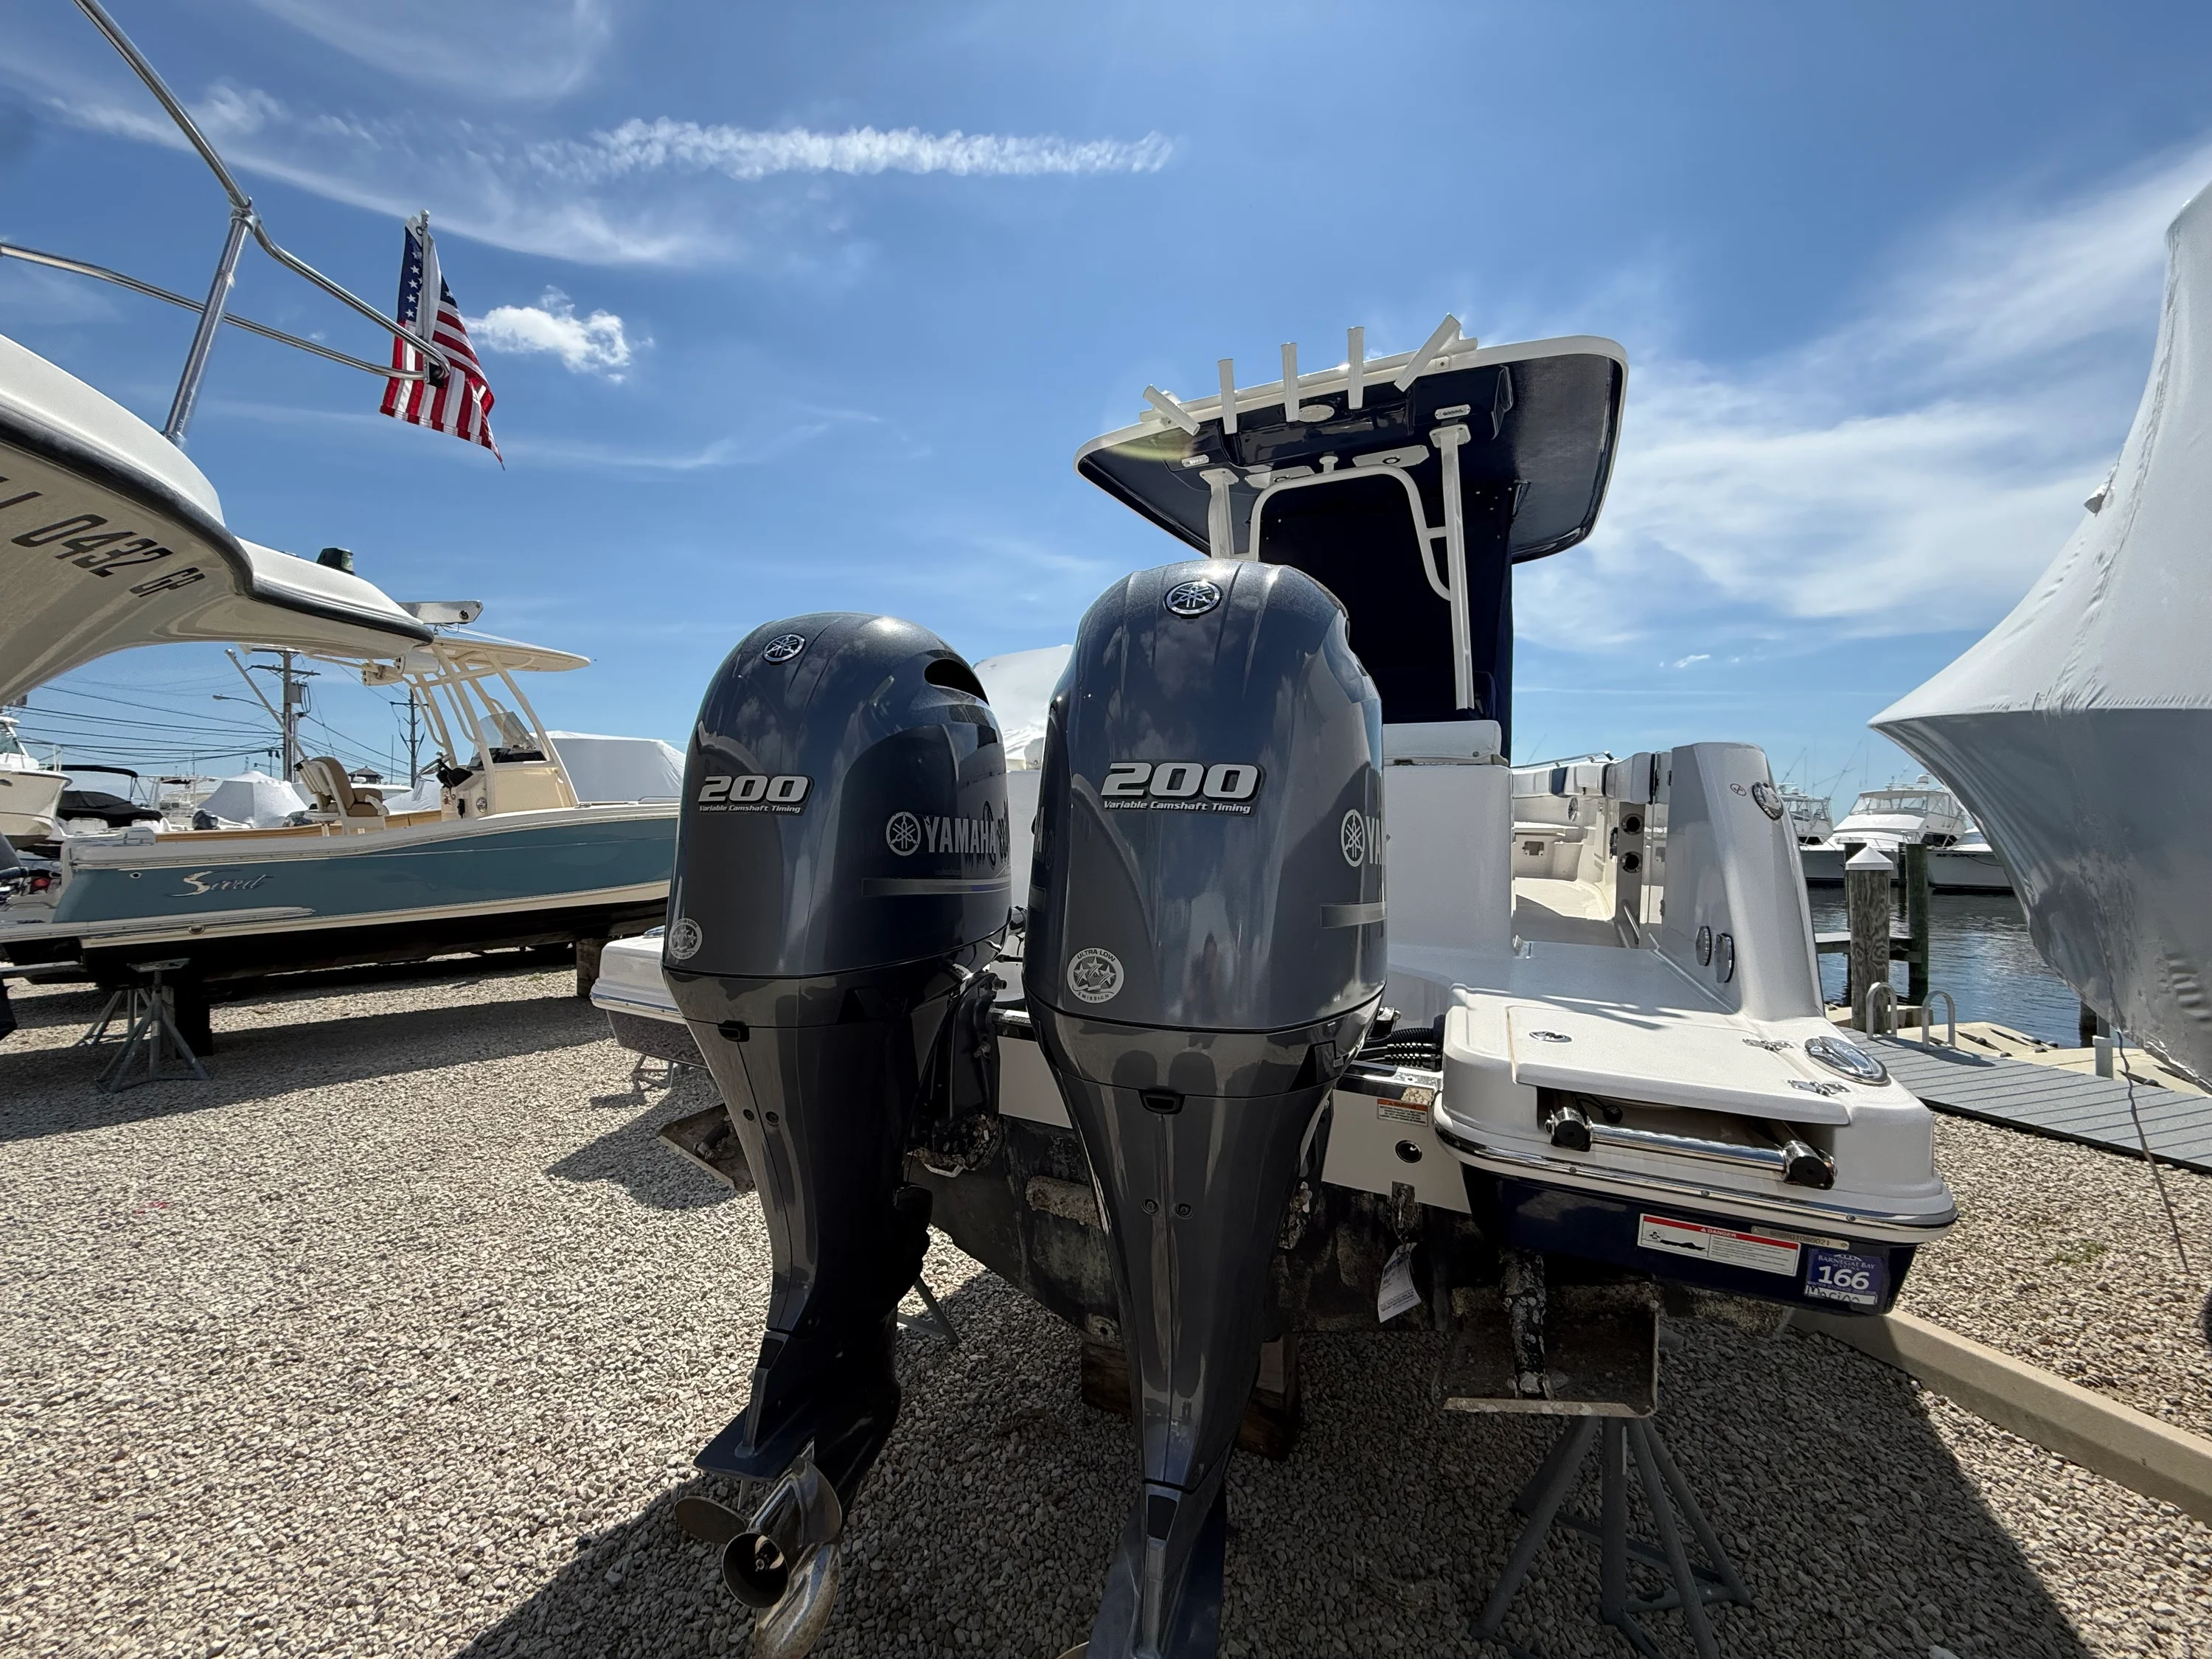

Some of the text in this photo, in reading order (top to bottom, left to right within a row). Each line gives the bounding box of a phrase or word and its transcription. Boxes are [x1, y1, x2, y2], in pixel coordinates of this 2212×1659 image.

[11, 514, 174, 577] 0432
[1101, 762, 1259, 799] 200
[698, 776, 809, 802] 200
[771, 805, 801, 814] Timing
[1104, 801, 1251, 814] Variable Camshaft Timing
[924, 816, 997, 854] YAMAHA
[1077, 948, 1116, 962] ULTRA LOW
[1078, 991, 1110, 1001] EMISSION
[1707, 1228, 1736, 1239] DANGER
[1818, 1254, 1860, 1267] BARNEGAT
[1818, 1265, 1870, 1290] 166
